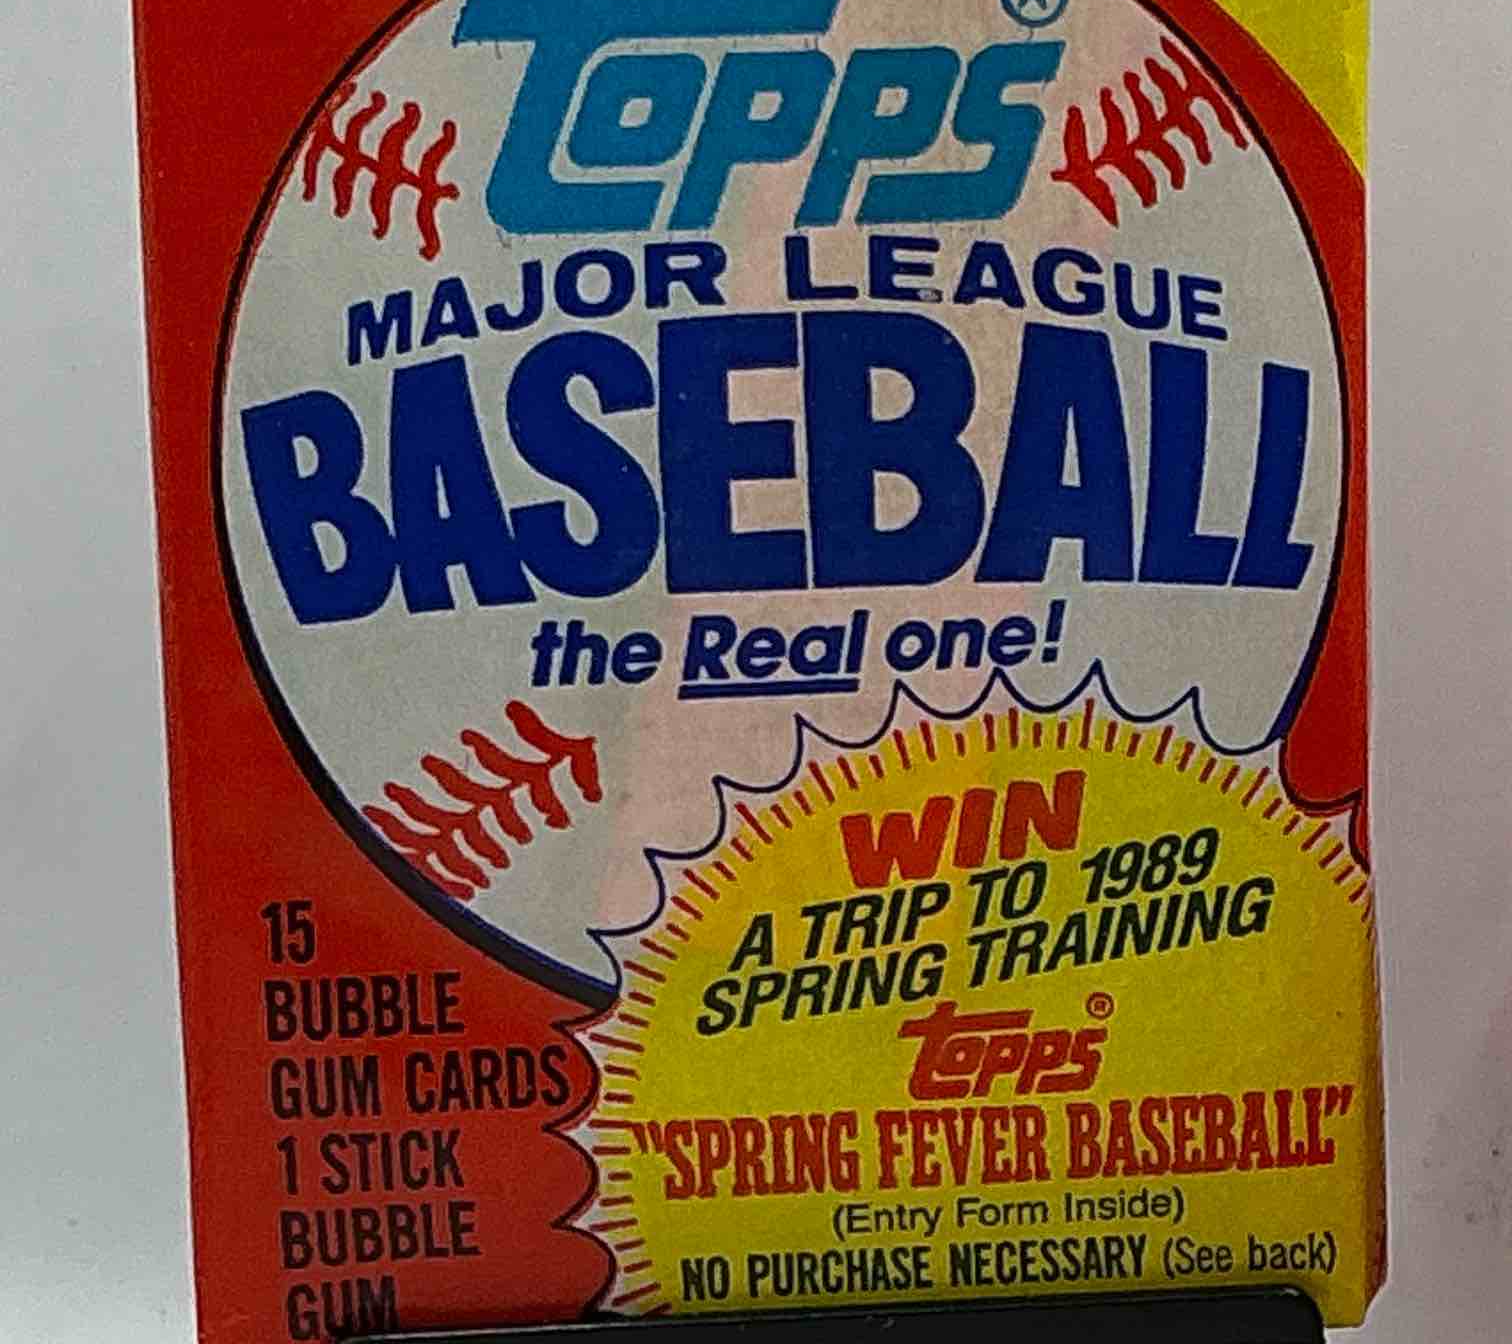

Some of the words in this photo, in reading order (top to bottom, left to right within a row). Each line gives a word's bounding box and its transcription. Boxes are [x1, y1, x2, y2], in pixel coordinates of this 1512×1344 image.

[348, 242, 727, 363] MAJOR
[784, 237, 1229, 342] LEAGUE
[239, 309, 1315, 625] BASEBALL
[532, 619, 661, 687] the
[679, 612, 864, 686] Real
[885, 601, 1064, 669] one!
[839, 770, 1087, 887] WIN
[260, 899, 316, 965] 15
[730, 912, 775, 972] A
[801, 881, 951, 959] TRIP
[970, 862, 1048, 926] TO
[1081, 827, 1221, 904] 1989
[696, 944, 948, 1035] SPRING
[968, 877, 1275, 988] TRAINING
[264, 972, 464, 1042] BUBBLE
[270, 1055, 382, 1120] GUM
[404, 1044, 571, 1113] CARDS
[276, 1135, 299, 1195] 1
[320, 1129, 464, 1194] STICK
[632, 1112, 862, 1200] "SPRING
[877, 1099, 1052, 1190] FEVER
[1066, 1085, 1354, 1184] BASEBALL"
[280, 1200, 481, 1269] BUBBLE
[833, 1201, 943, 1242] (Entry
[956, 1199, 1050, 1230] Form
[1064, 1187, 1185, 1224] Inside)
[680, 1256, 730, 1302] NO
[748, 1247, 934, 1298] PURCHASE
[949, 1235, 1147, 1289] NECESSARY
[1163, 1238, 1234, 1280] (See
[1247, 1230, 1337, 1274] back)
[286, 1276, 398, 1342] GUM
